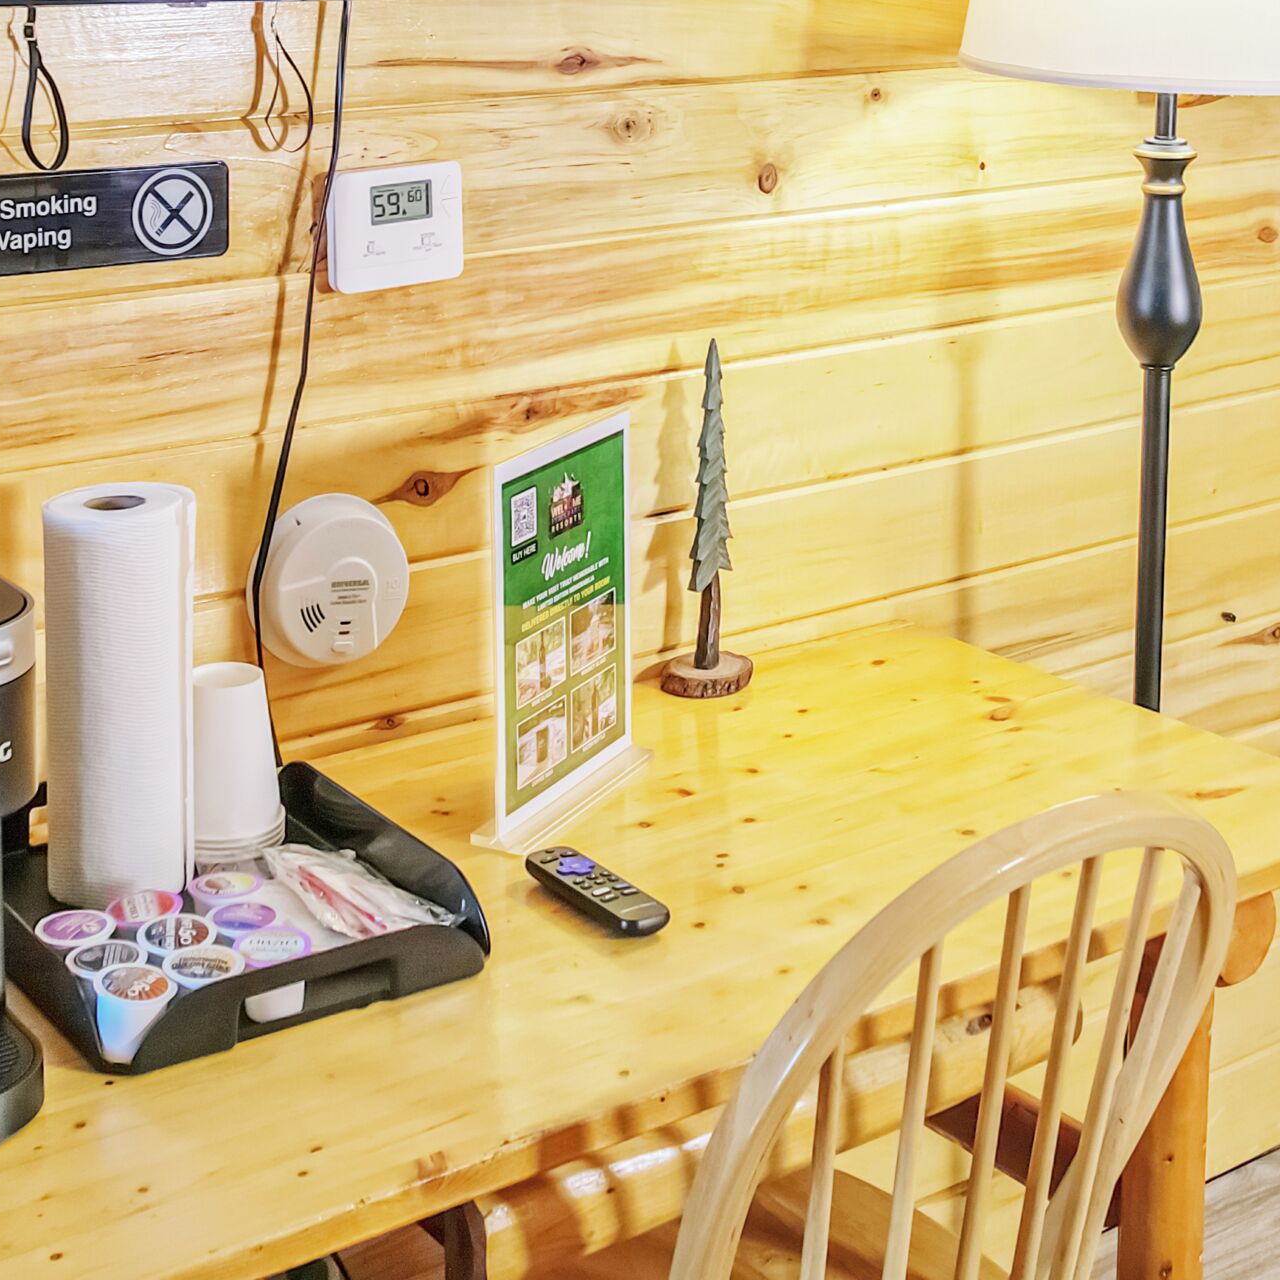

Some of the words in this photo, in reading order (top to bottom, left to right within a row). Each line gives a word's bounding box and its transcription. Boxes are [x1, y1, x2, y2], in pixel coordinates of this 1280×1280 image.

[0, 194, 97, 220] Smoking
[373, 192, 400, 218] 59
[523, 543, 537, 558] HERE
[541, 531, 592, 581] Welcome!
